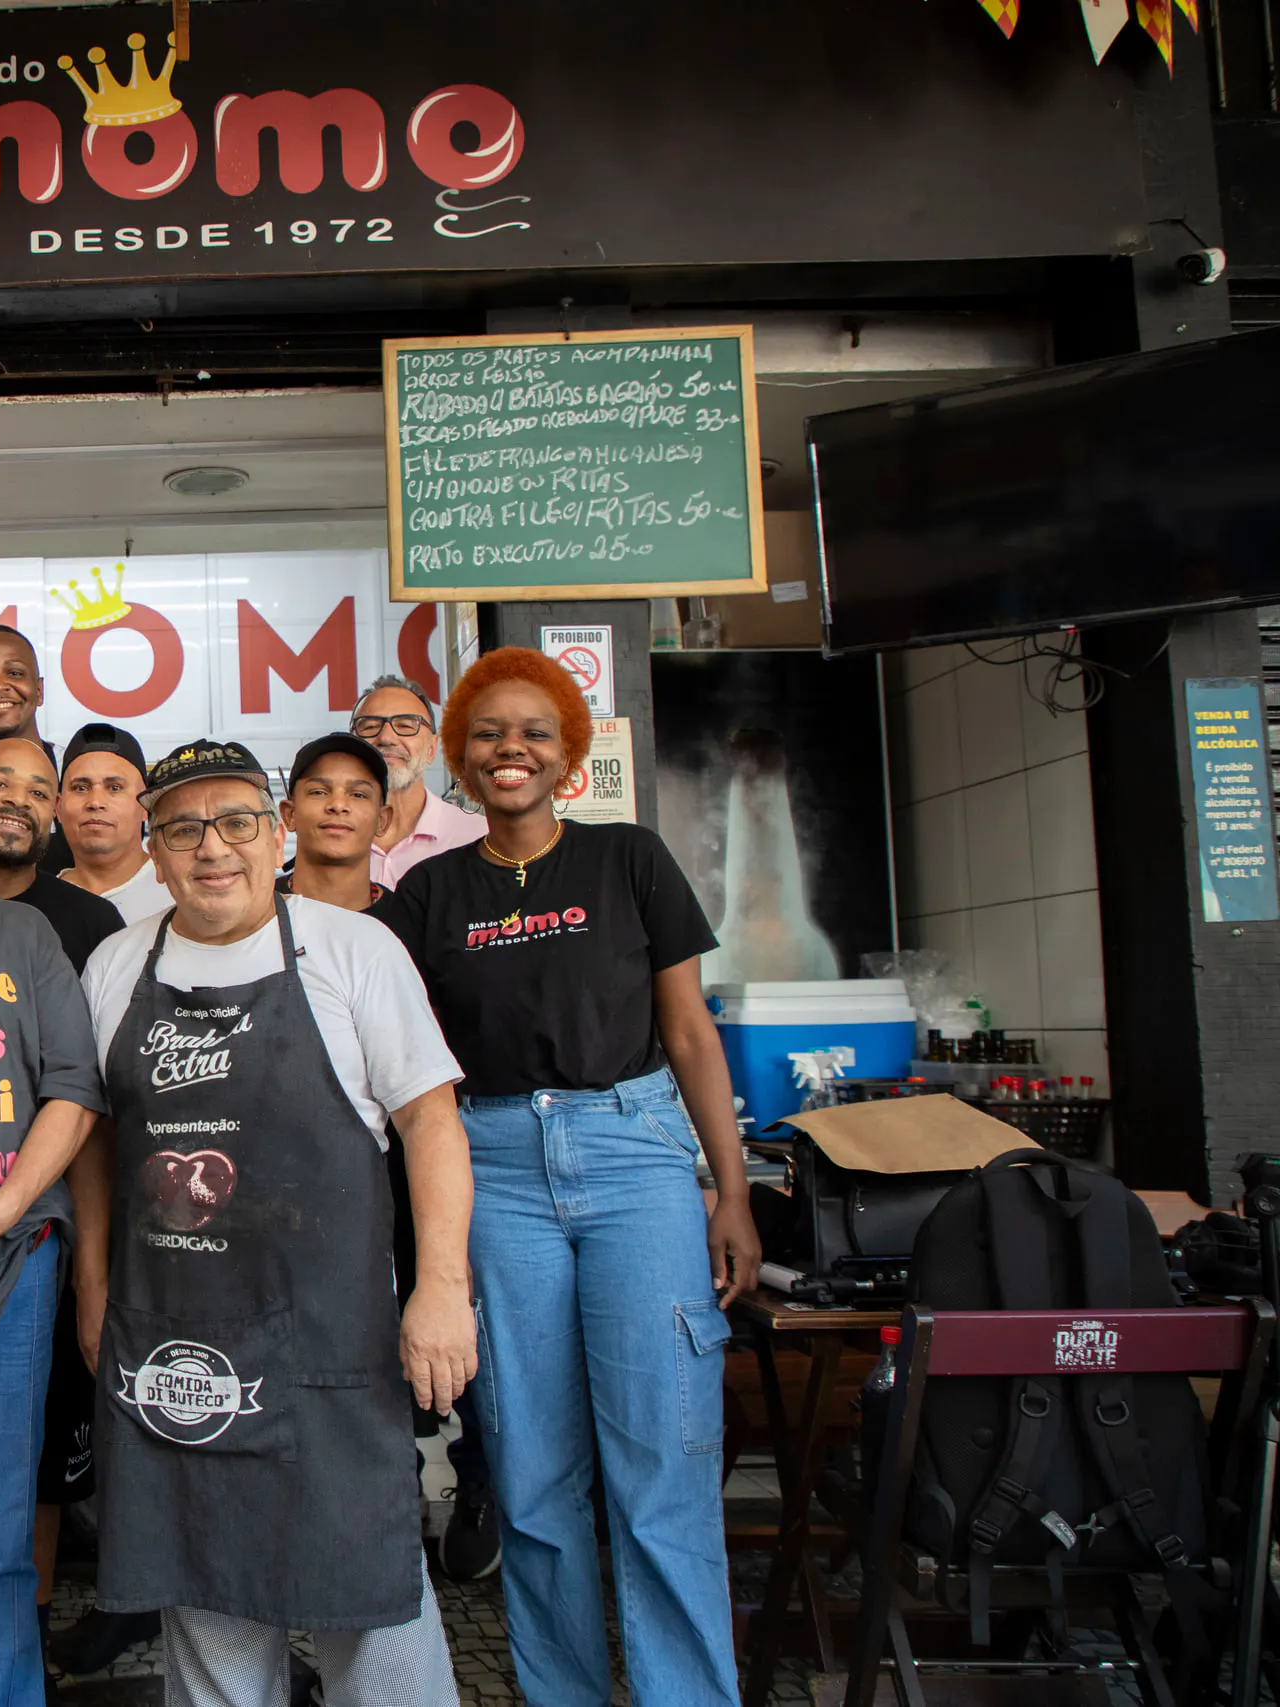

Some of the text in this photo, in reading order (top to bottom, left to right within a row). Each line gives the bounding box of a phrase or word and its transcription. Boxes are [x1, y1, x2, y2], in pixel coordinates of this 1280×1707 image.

[30, 219, 394, 254] DESDE 1972
[462, 351, 487, 366] OS
[551, 631, 603, 644] PROIBIDO
[1194, 711, 1250, 720] VENDA DE
[1195, 725, 1237, 735] BEBIDA
[592, 759, 621, 776] RIO
[1214, 762, 1254, 773] proibido
[593, 776, 622, 789] SEM
[1221, 774, 1250, 783] venda
[593, 789, 622, 799] FUMO
[1206, 785, 1258, 795] de bebidas
[1206, 808, 1262, 818] menores de
[1210, 844, 1264, 854] Lei Federal
[467, 906, 587, 947] momo
[468, 920, 499, 930] BAR do
[488, 929, 561, 946] DESDE 1972
[175, 1007, 209, 1019] Cerveja
[151, 1049, 232, 1087] Extra
[146, 1119, 240, 1136] Apresentação:
[148, 1233, 228, 1252] PERDIGÃO
[1056, 1330, 1118, 1348] DUPLO
[1055, 1348, 1117, 1366] MALTE
[155, 1373, 212, 1393] COMIDA
[147, 1386, 164, 1401] DI
